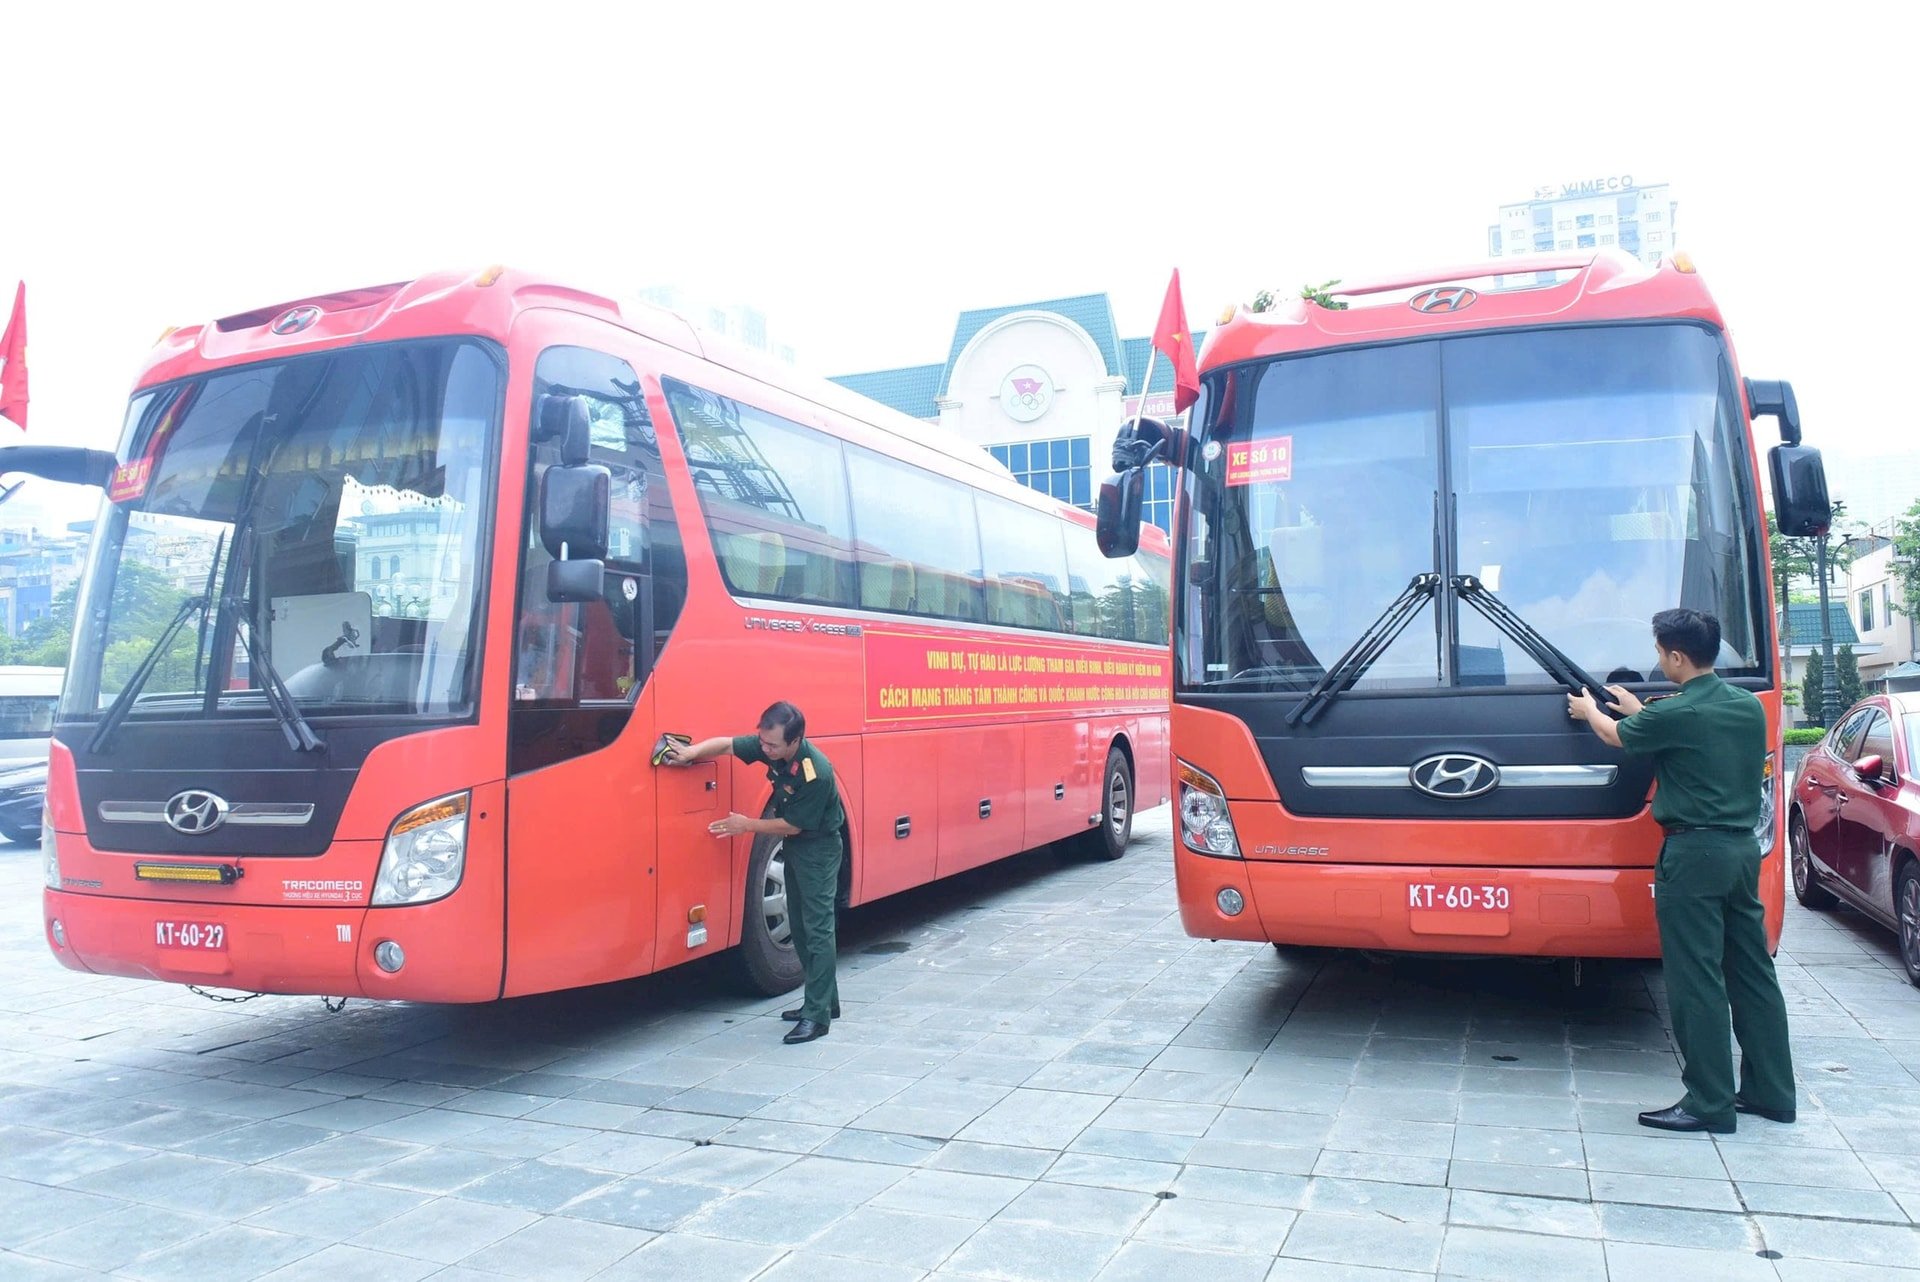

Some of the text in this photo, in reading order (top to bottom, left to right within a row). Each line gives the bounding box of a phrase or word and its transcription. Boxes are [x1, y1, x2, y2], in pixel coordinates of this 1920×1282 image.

[1562, 175, 1633, 195] VIMECO
[1232, 443, 1287, 466] XE SỐ 10
[927, 650, 949, 670] VINH
[951, 651, 966, 673] DỰ,
[967, 652, 979, 674] TỰ
[980, 650, 997, 671] HÀO
[998, 651, 1008, 671] LÀ
[1009, 654, 1023, 675] LỰC
[1024, 655, 1045, 675] LƯỢNG
[1046, 657, 1064, 673] THAM
[1064, 659, 1075, 674] GIA
[880, 684, 909, 708] CÁCH
[911, 688, 942, 711] MẠNG
[943, 684, 972, 706] THÁNG
[974, 684, 991, 705] TÁM
[993, 684, 1018, 704] THÀNH
[1019, 684, 1038, 703] CÔNG
[1038, 685, 1048, 703] VÀ
[1048, 684, 1065, 703] QUỐC
[1065, 684, 1086, 702] KHÁNH
[282, 880, 362, 890] TRACOMECO
[343, 891, 350, 902] 3
[1409, 884, 1509, 909] KT-60-30
[156, 921, 224, 948] KT-60-29
[336, 924, 351, 942] TM
